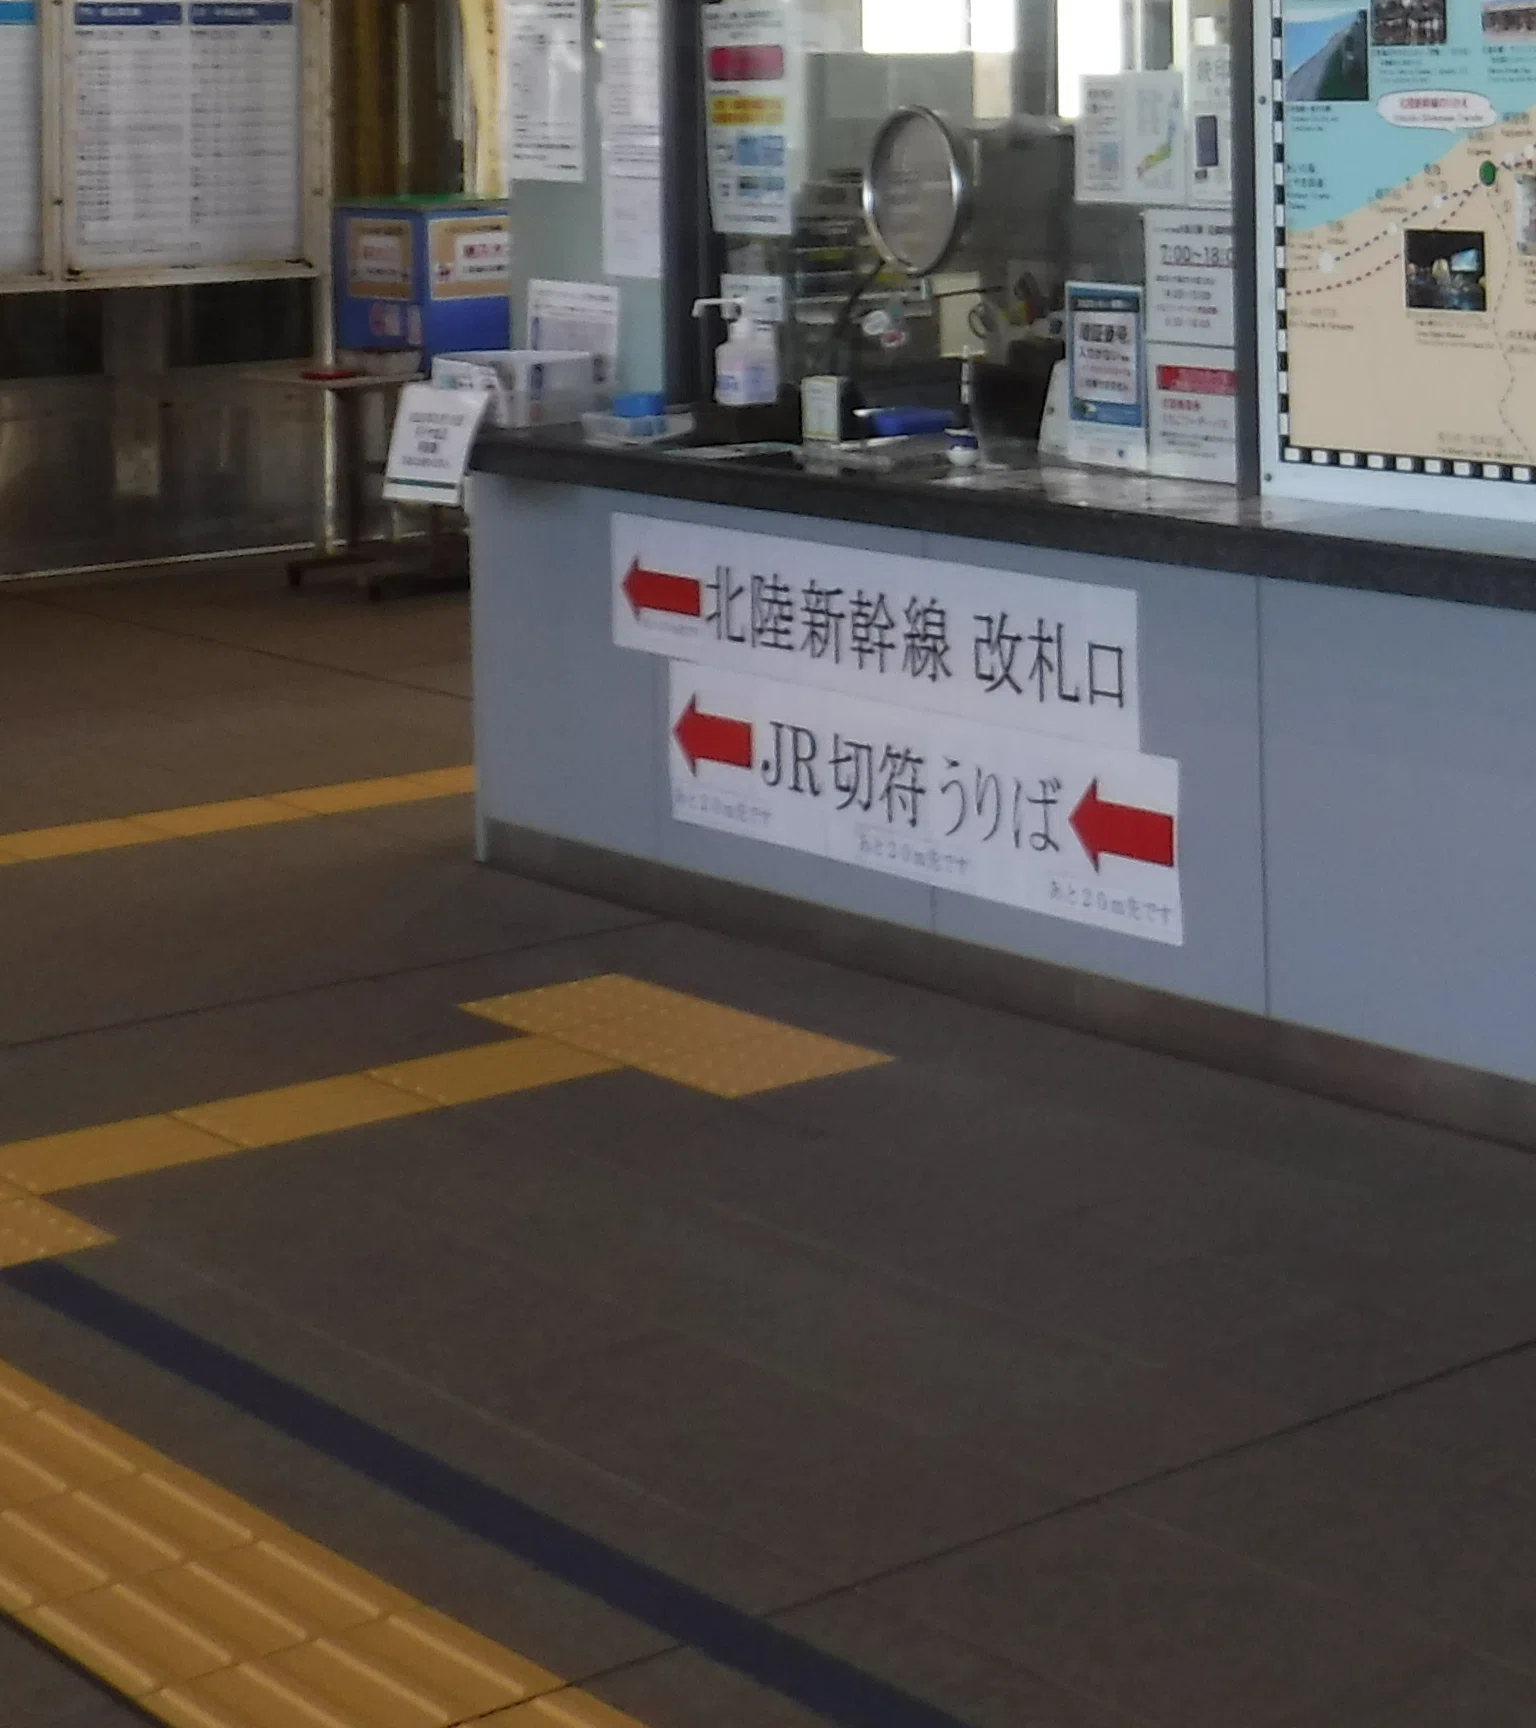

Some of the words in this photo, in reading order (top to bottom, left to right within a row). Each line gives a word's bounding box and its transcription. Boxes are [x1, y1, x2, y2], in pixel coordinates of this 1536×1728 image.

[705, 566, 953, 683] 北陸新幹線
[973, 613, 1125, 709] 改札口
[761, 721, 1061, 853] JR切符うりば
